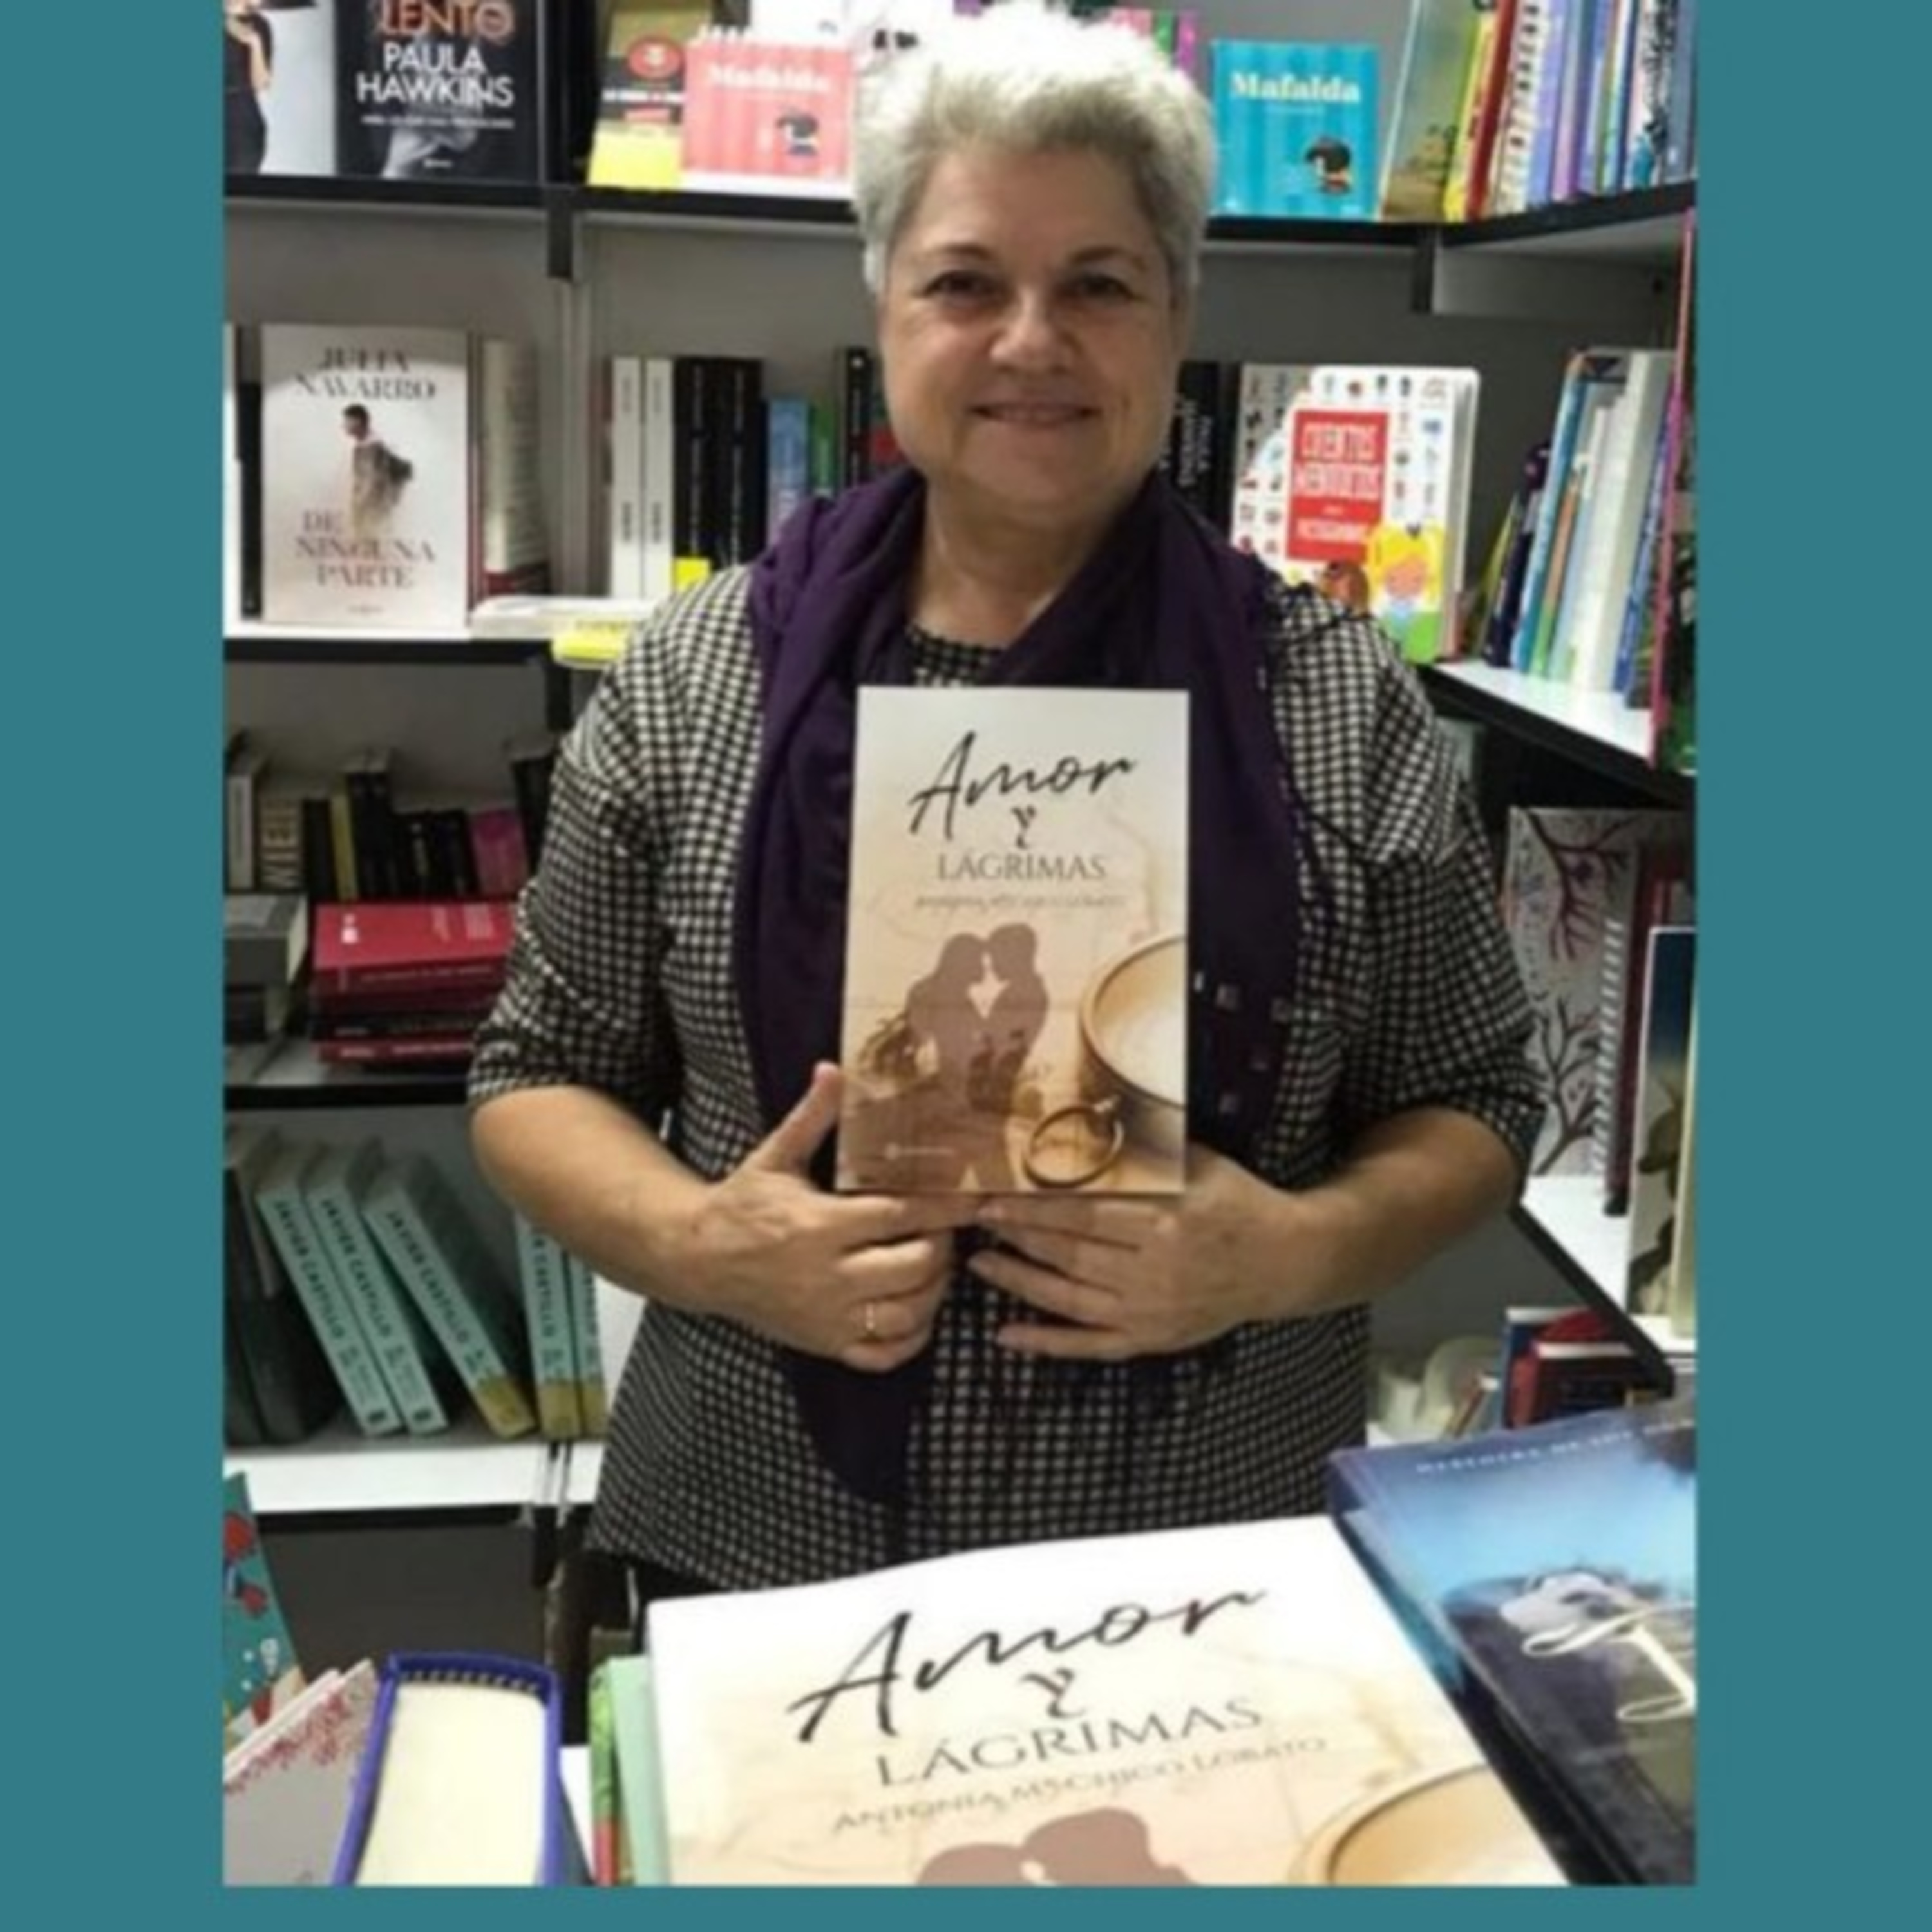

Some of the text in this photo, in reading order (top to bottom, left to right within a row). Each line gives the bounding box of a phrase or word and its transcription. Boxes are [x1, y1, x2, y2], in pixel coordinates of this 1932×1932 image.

[383, 41, 488, 73] PAULA
[357, 73, 515, 108] HAWKINS
[1231, 72, 1360, 103] Mafalda
[320, 347, 410, 372] JULIA
[295, 373, 437, 401] NAVARRO
[303, 510, 343, 533] DE
[296, 536, 436, 563] NINGUNA
[317, 564, 414, 590] PARTE
[908, 730, 1136, 841] Amor
[785, 1589, 1267, 1743] Amor
[876, 1696, 1264, 1788] LÁGRIMAS
